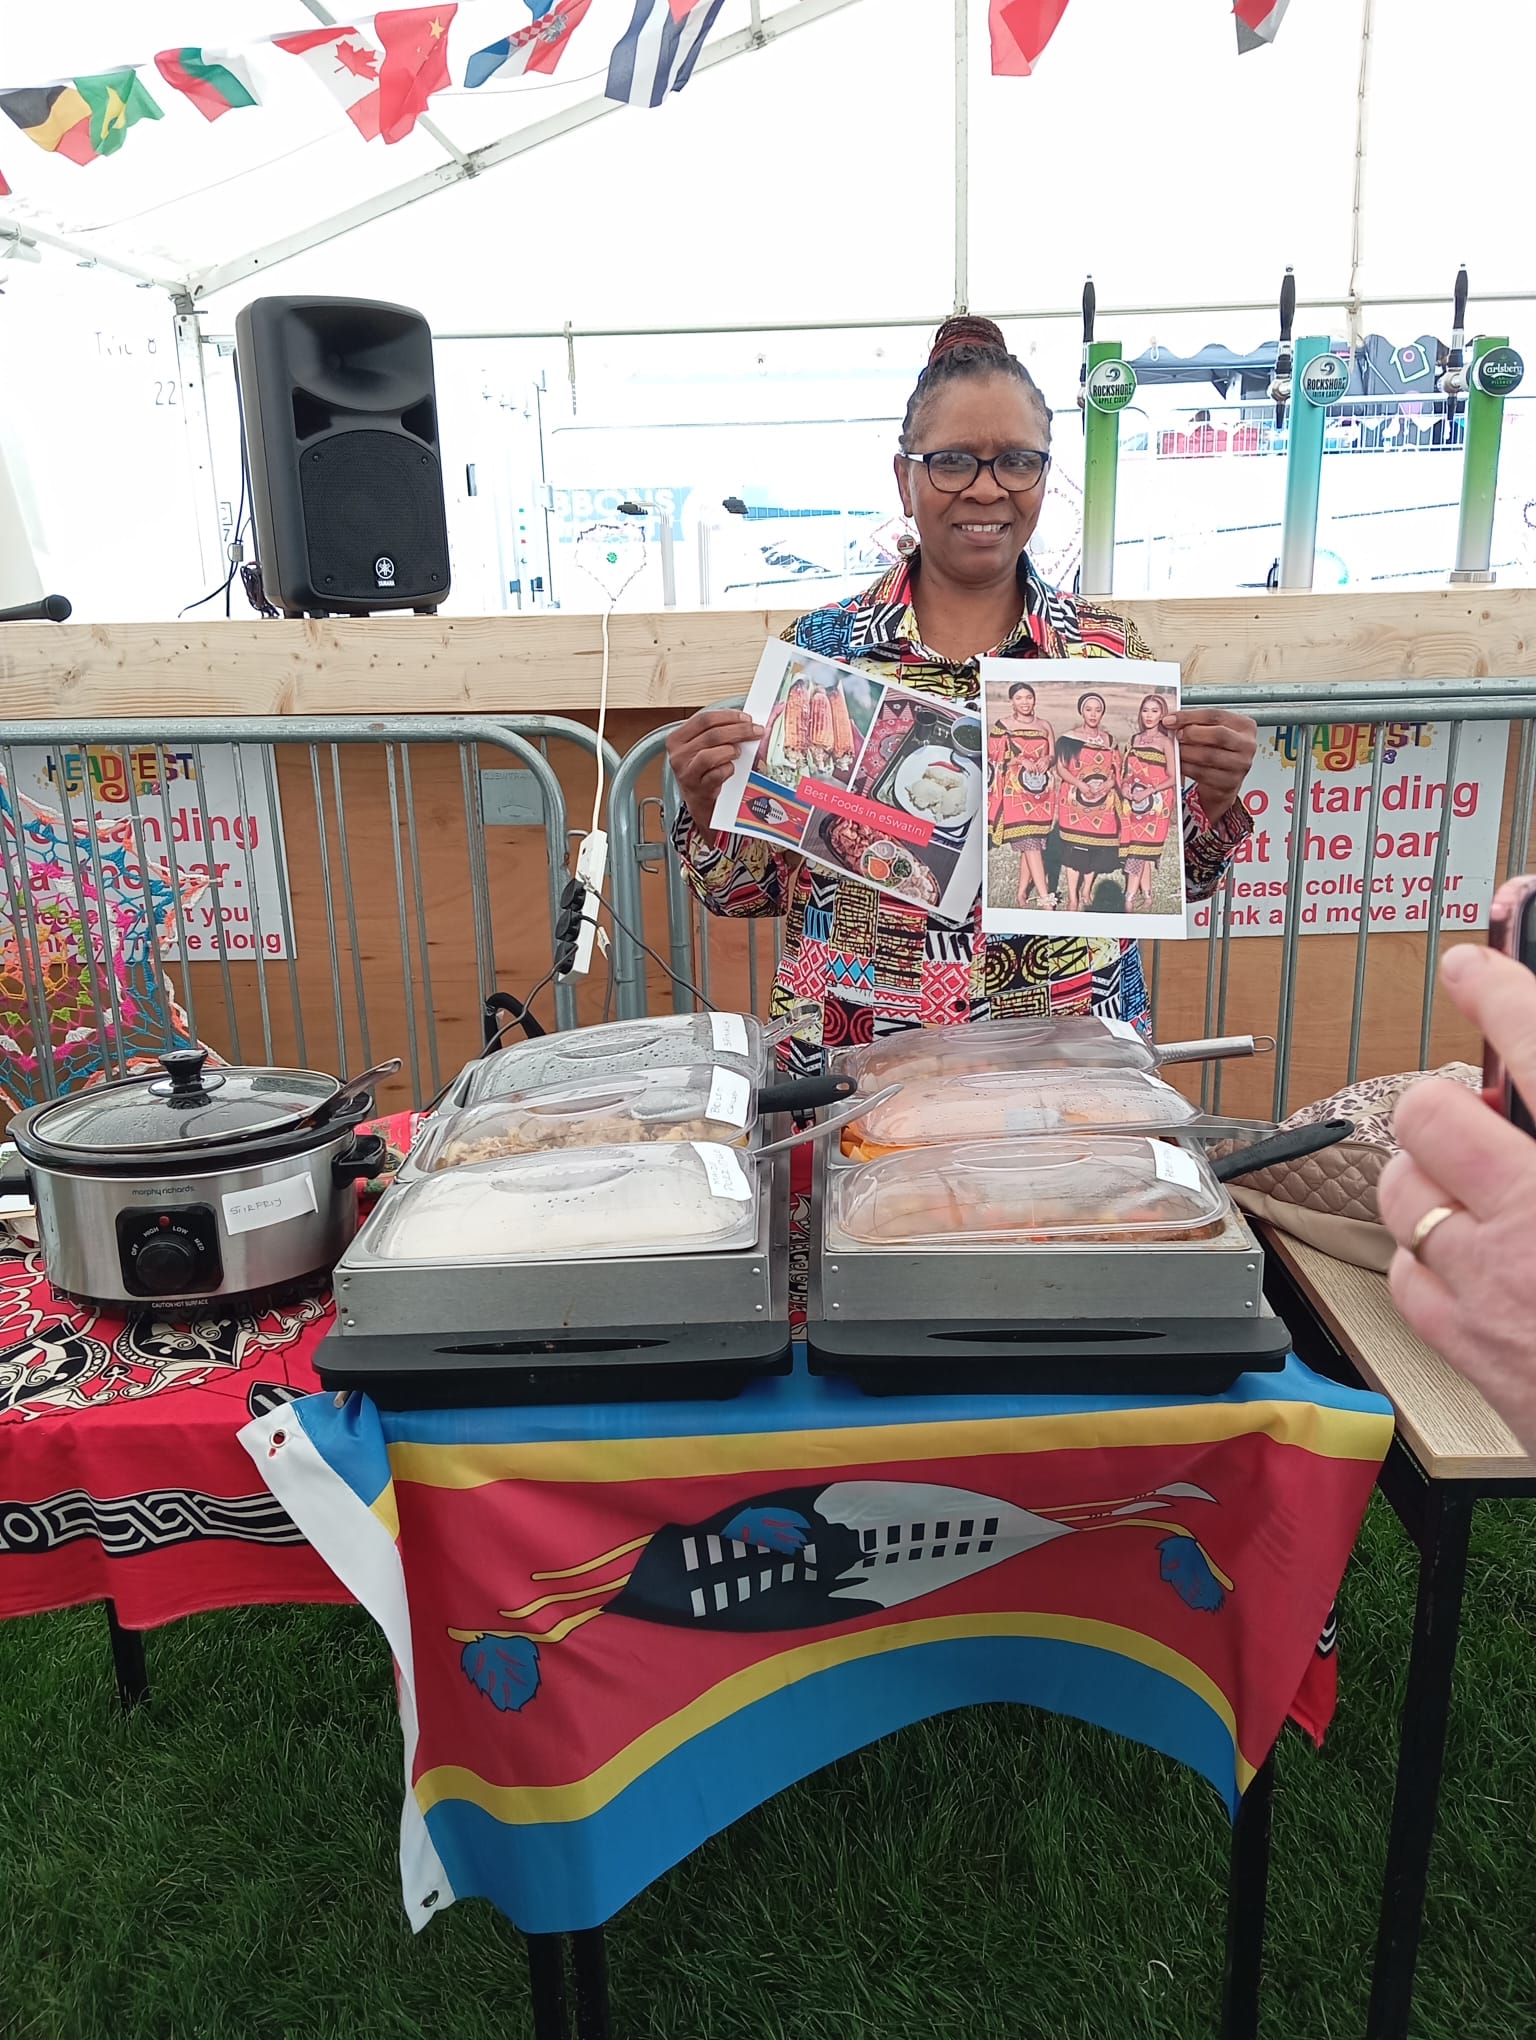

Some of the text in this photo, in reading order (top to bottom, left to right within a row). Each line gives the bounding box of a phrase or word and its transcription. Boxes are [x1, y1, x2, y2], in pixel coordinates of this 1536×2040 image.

[1483, 361, 1523, 376] Carlsberg
[1093, 383, 1133, 397] ROCKSHORE
[1307, 377, 1347, 391] ROCKSHORE
[1242, 789, 1269, 815] o
[803, 785, 926, 837] Best Foods in eSwatini
[1233, 830, 1271, 864] at
[1218, 873, 1464, 898] lease collect your
[1193, 899, 1479, 927] dnk ad move alng
[131, 1185, 194, 1196] morphy richards
[143, 1226, 160, 1238] HIGH
[172, 1225, 189, 1235] LOW
[131, 1243, 139, 1256] OFF
[194, 1238, 205, 1251] MED
